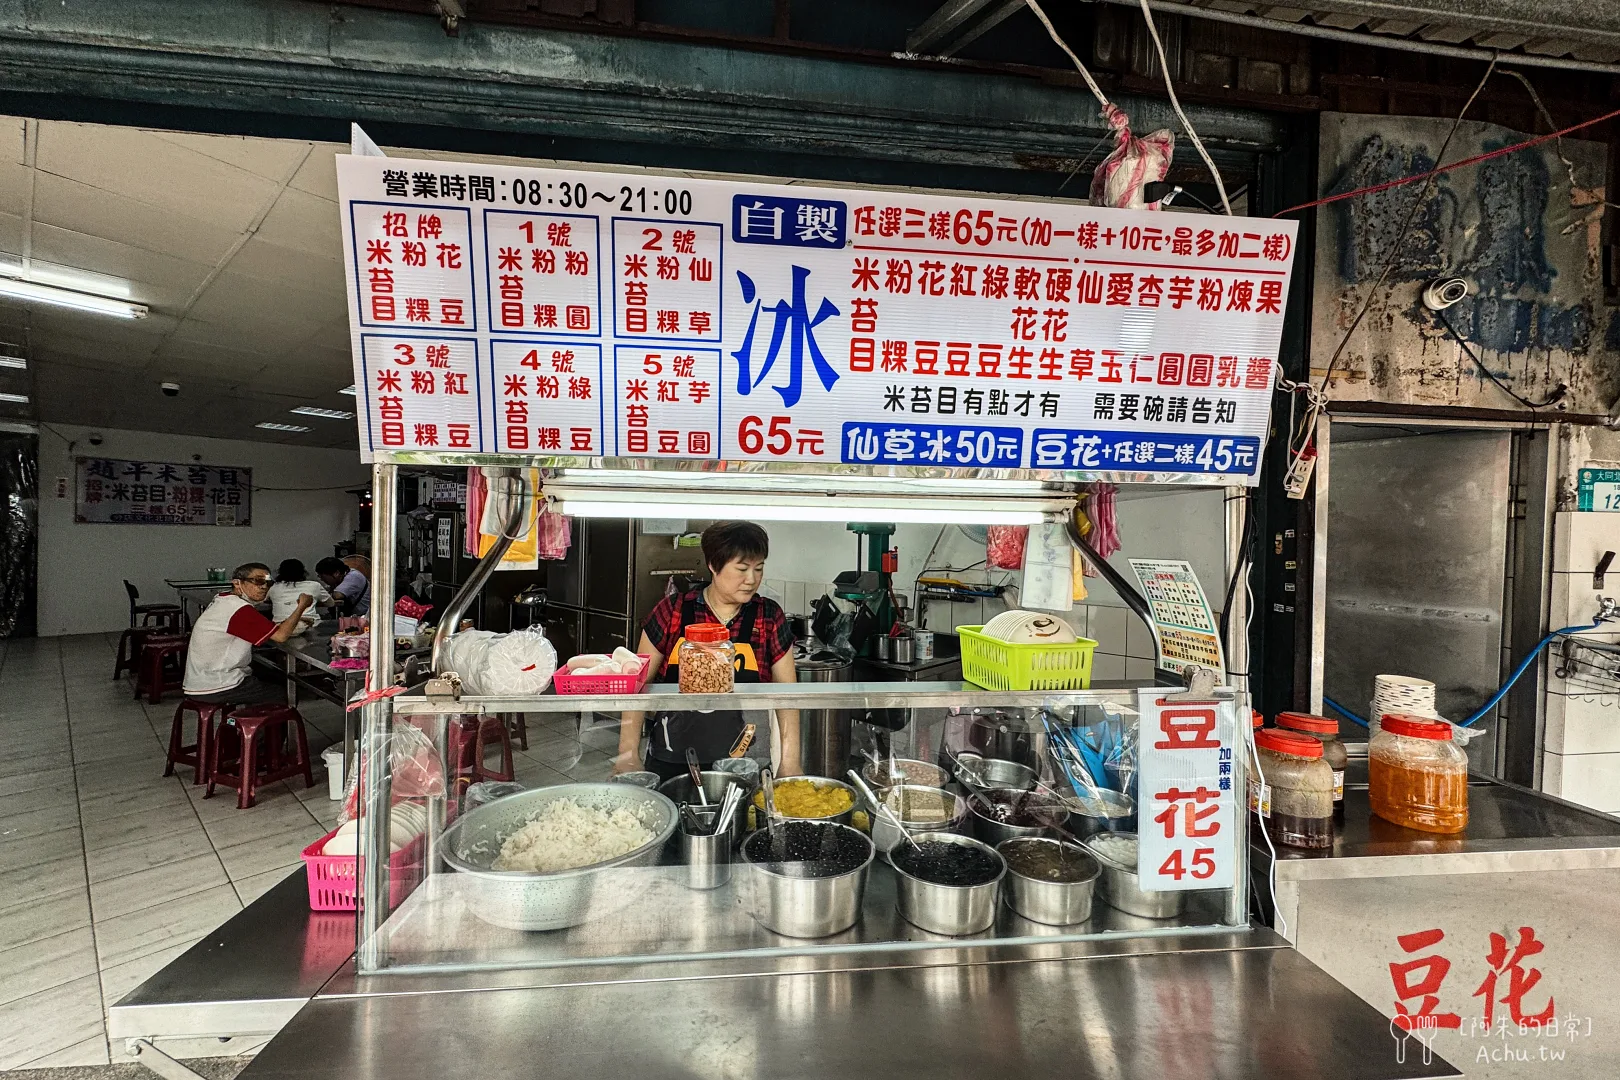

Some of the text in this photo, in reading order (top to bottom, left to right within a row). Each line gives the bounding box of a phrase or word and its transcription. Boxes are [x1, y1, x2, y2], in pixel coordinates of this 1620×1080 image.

[383, 212, 442, 239] 招牌
[519, 221, 571, 247] 1號
[740, 201, 838, 244] 自製
[642, 228, 695, 254] 2號
[731, 264, 841, 408] 冰
[395, 344, 449, 368] 3號
[520, 350, 574, 372] 4號
[644, 354, 695, 377] 5號
[884, 385, 1060, 417] 米苔目有點才有
[1094, 393, 1236, 423] 需要碗請告知
[738, 416, 824, 455] 65元
[846, 426, 1018, 465] 仙草冰50元
[1035, 433, 1254, 471] 豆花+任選二樣45元
[1155, 698, 1220, 838] 豆花
[1219, 747, 1231, 790] 加兩樣
[1159, 848, 1215, 880] 45
[1389, 927, 1555, 1031] 豆花
